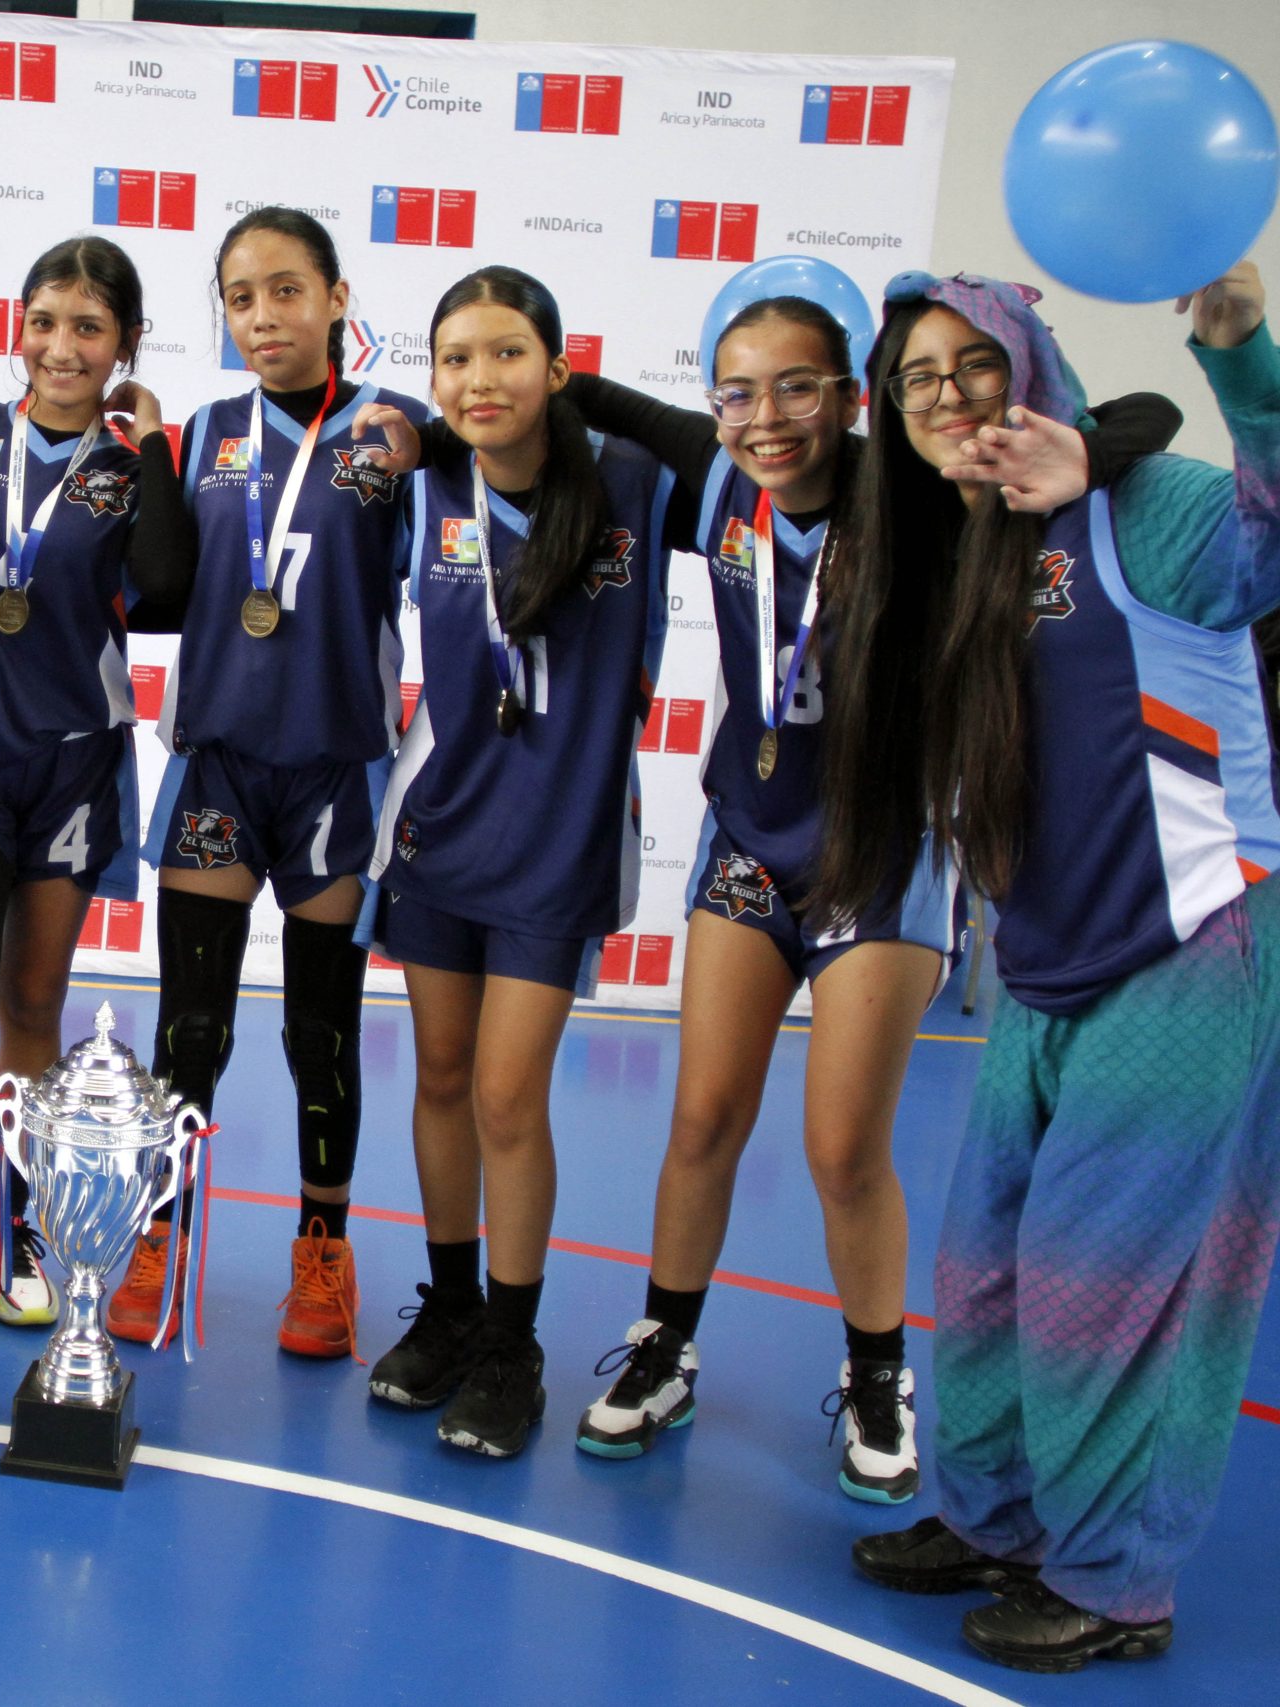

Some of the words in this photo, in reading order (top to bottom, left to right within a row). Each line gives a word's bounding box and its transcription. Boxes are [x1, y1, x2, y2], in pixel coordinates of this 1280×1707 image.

[128, 60, 163, 79] IND
[94, 80, 122, 95] Arica
[124, 84, 133, 97] y
[135, 83, 197, 100] Parinacota
[406, 76, 450, 94] Chile
[405, 95, 482, 115] Compite
[697, 91, 732, 109] IND
[660, 112, 690, 127] Arica
[692, 117, 701, 129] y
[704, 114, 766, 130] Parinacota
[225, 200, 341, 220] #Chilpite
[523, 216, 603, 235] #INDArica
[786, 230, 903, 250] #ChileCompite
[139, 341, 186, 354] rinacota
[391, 332, 431, 349] Chile
[675, 350, 701, 366] IN
[639, 370, 668, 383] Arica
[670, 374, 677, 385] y
[225, 472, 274, 481] PARINTA
[341, 470, 355, 479] EL
[359, 472, 391, 490] ROBLE
[74, 488, 87, 496] EL
[250, 481, 260, 500] IND
[252, 538, 262, 559] IND
[9, 567, 18, 587] IND
[280, 532, 313, 611] 7
[447, 566, 452, 575] Y
[454, 566, 501, 576] PARINACA
[592, 563, 623, 574] OBLE
[1033, 592, 1061, 605] BLE
[667, 616, 714, 629] rinacota
[776, 645, 824, 725] 8
[48, 803, 91, 875] 4
[185, 836, 197, 847] EL
[201, 840, 230, 853] ROBLE
[640, 857, 686, 869] rinacota
[716, 882, 728, 892] EL
[731, 885, 767, 904] ROBLE
